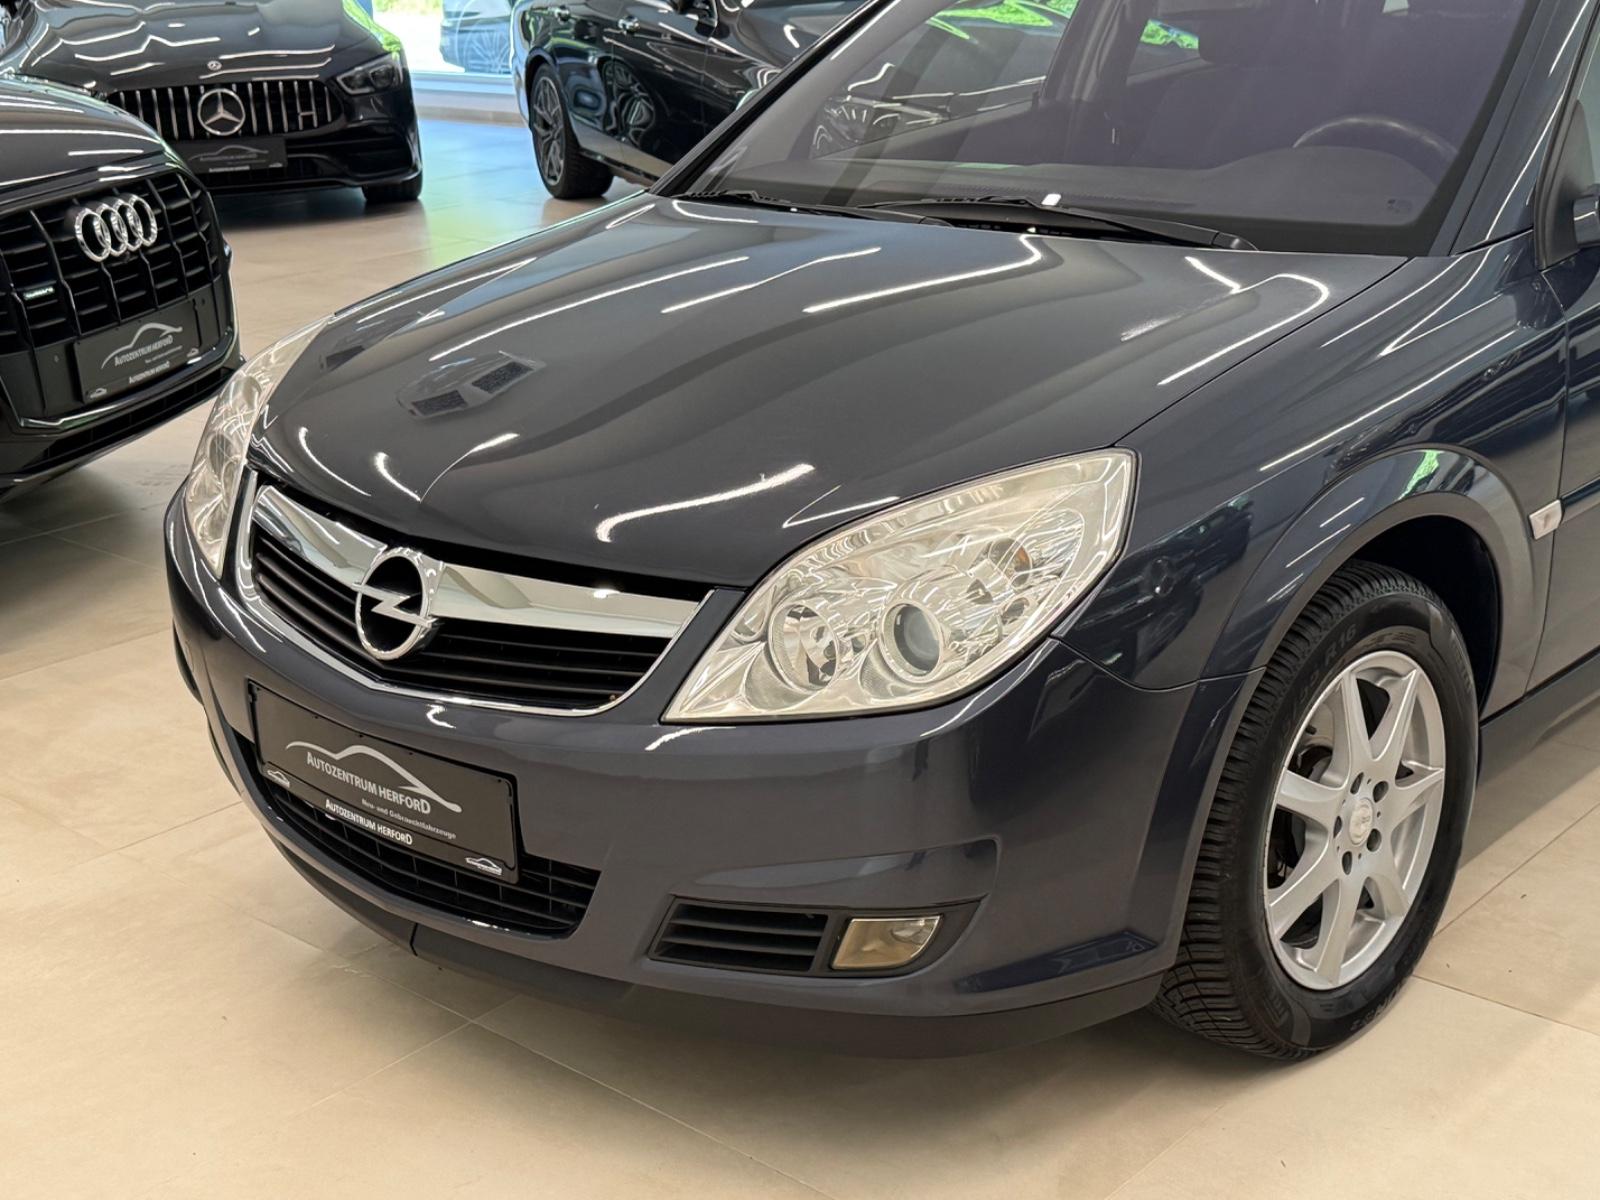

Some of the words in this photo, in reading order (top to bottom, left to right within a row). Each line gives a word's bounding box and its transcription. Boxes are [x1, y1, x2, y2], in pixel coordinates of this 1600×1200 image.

[306, 751, 377, 795] AUTOZENTRUM
[378, 787, 431, 814] HERFORD
[325, 799, 376, 831] AUTOZENTRUM
[377, 823, 413, 845] HERFORD
